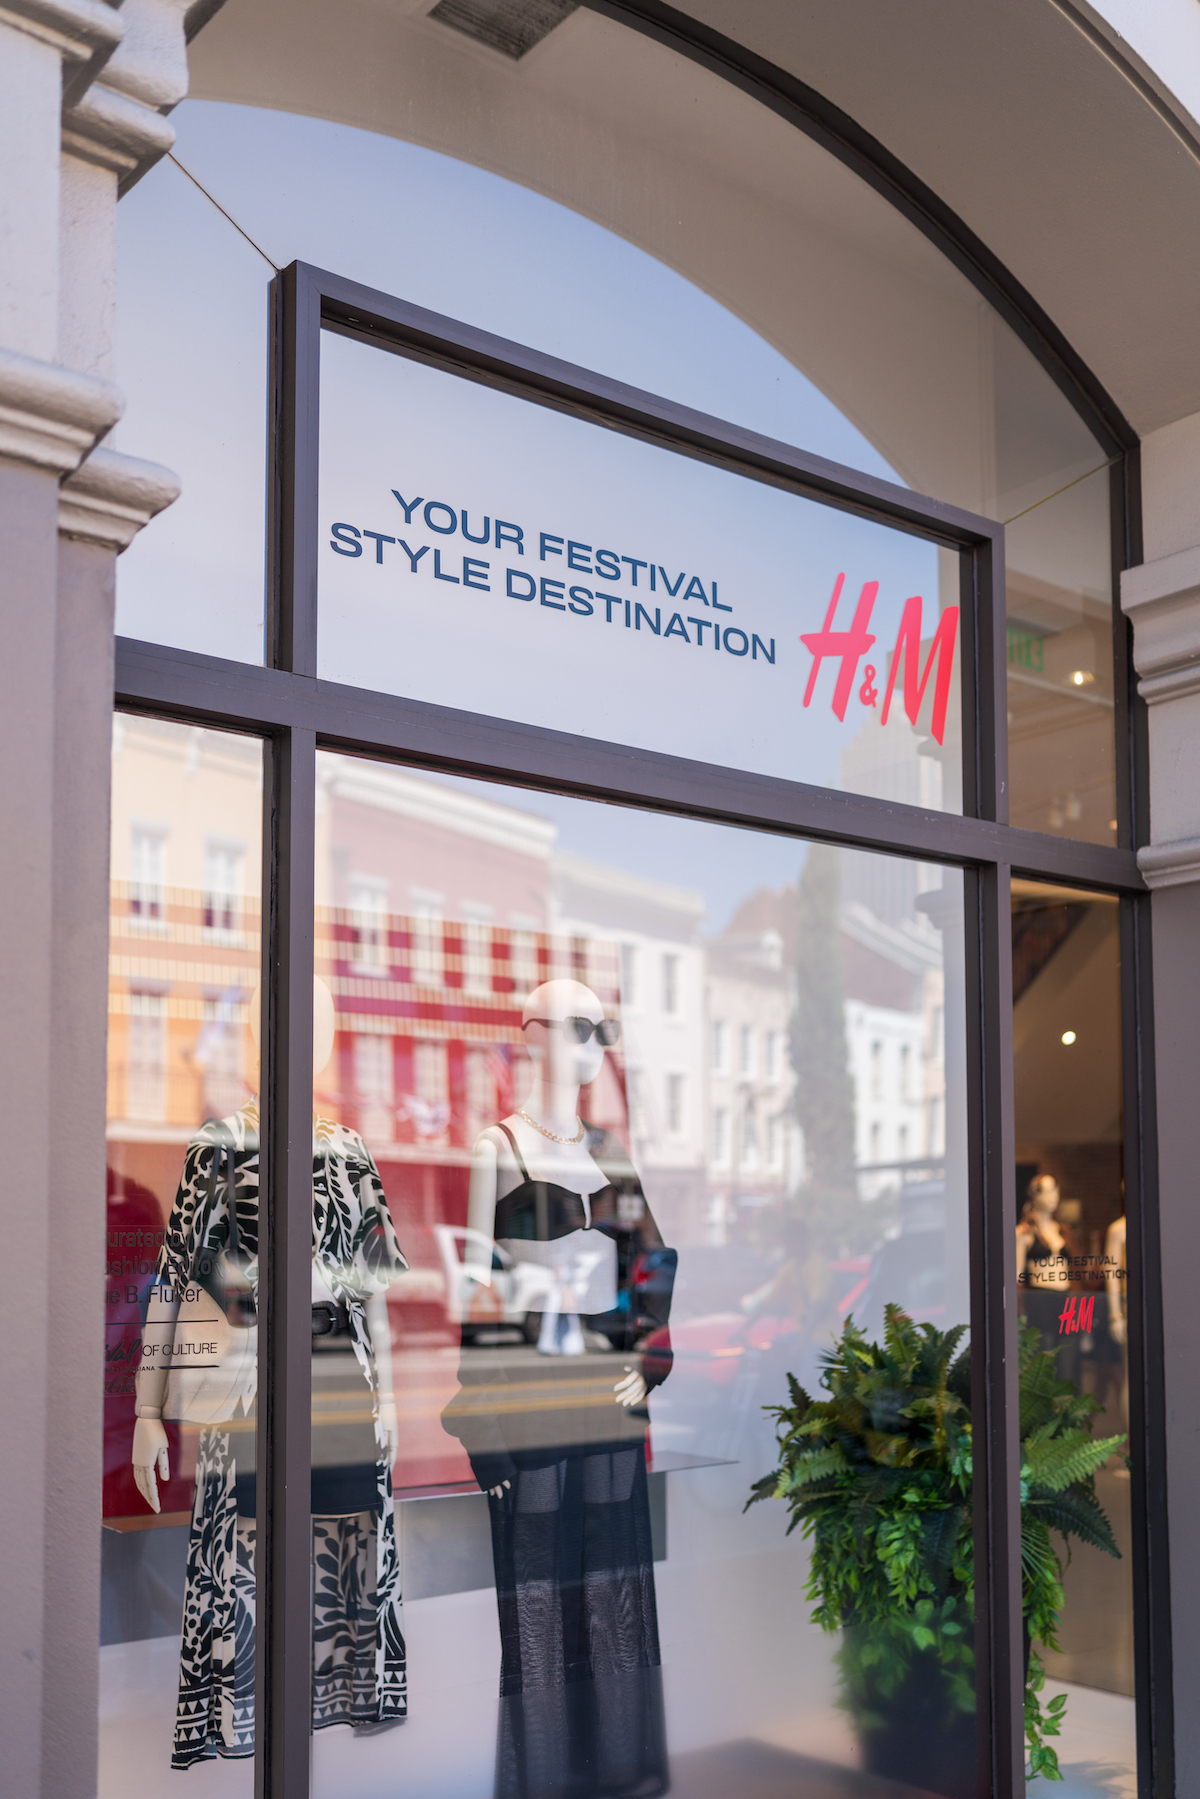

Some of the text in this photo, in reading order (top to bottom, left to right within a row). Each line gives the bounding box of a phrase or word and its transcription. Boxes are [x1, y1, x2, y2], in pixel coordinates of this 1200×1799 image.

[391, 489, 733, 613] YOUR FESTIVAL
[330, 522, 776, 665] STYLE DESTINATION
[800, 571, 960, 747] H&M
[106, 1228, 165, 1248] urated
[104, 1255, 219, 1276] ashion Editor
[1032, 1255, 1118, 1268] YOUR FESTIVAL
[1018, 1269, 1131, 1284] STYLE DESTINATION
[126, 1285, 142, 1304] B.
[149, 1285, 203, 1304] Fluker
[1058, 1295, 1095, 1336] H&M
[142, 1344, 160, 1357] OF
[162, 1342, 218, 1356] CULTURE
[120, 1365, 156, 1373] LOUISIANA
